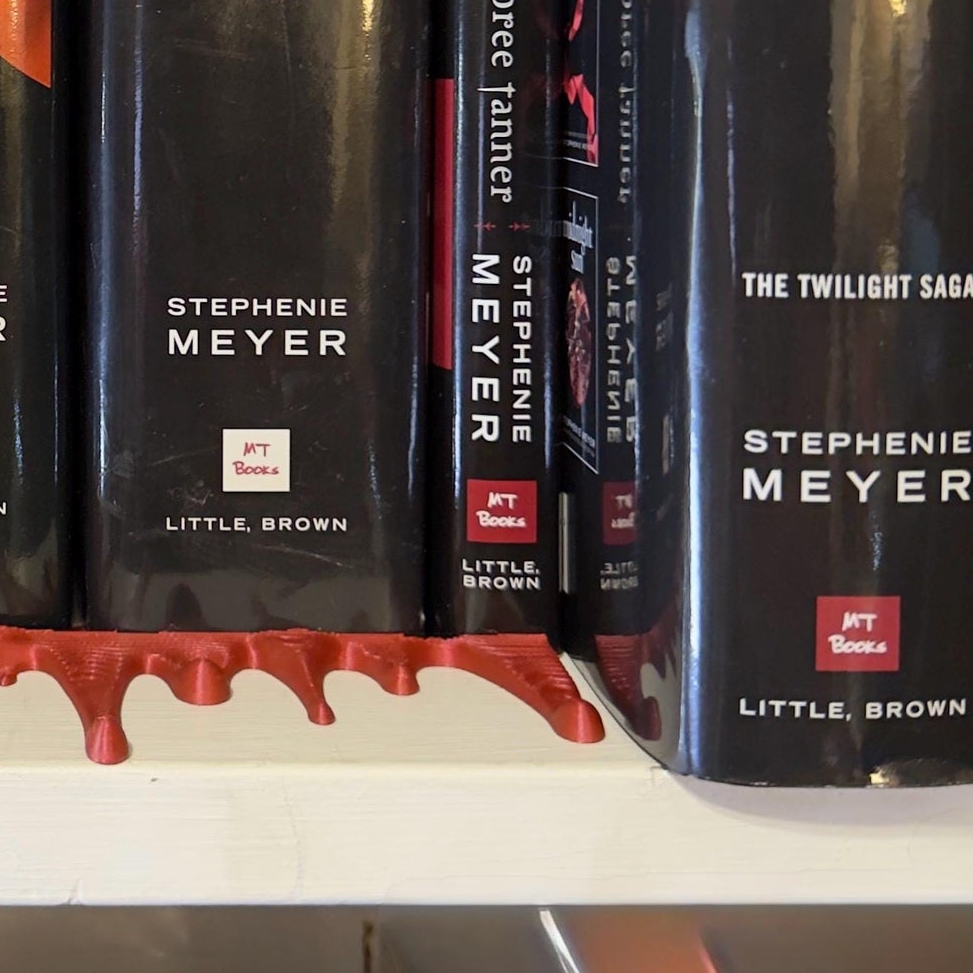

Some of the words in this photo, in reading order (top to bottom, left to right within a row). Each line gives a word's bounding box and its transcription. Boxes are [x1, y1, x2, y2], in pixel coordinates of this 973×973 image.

[476, 81, 517, 204] tanner
[741, 272, 790, 298] THE
[796, 273, 912, 299] TWILIGHT
[919, 273, 973, 300] SAGA
[166, 297, 348, 317] STEPHENIE
[167, 329, 347, 356] MEYER
[470, 253, 501, 443] MEYER
[511, 255, 532, 443] STEPHENIE
[243, 442, 271, 457] MT
[743, 429, 972, 456] STEPHENIE
[742, 467, 973, 504] MEYER
[487, 491, 519, 510] MT
[165, 516, 252, 533] LITTLE,
[261, 516, 348, 532] BROWN
[462, 558, 540, 575] LITTLE,
[463, 573, 541, 590] BROWN
[842, 611, 878, 632] MT
[738, 697, 852, 722] LITTLE,
[864, 698, 967, 720] BROWN
